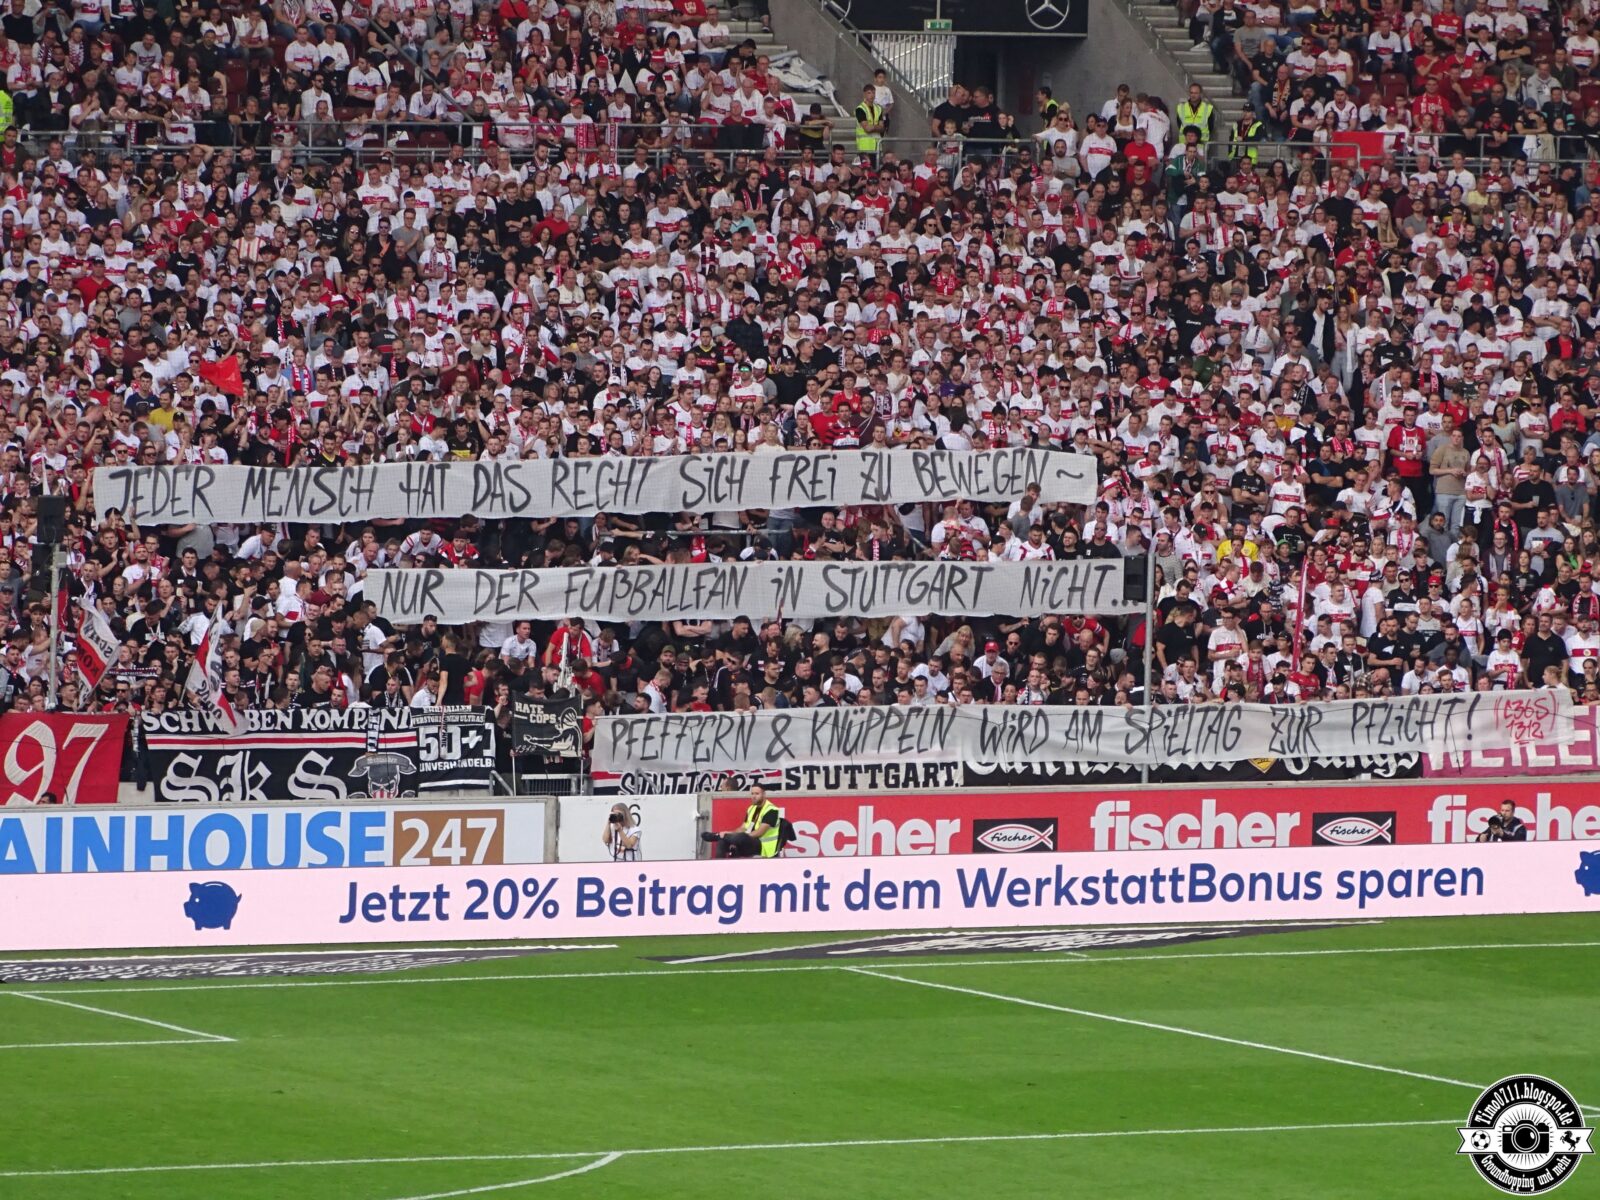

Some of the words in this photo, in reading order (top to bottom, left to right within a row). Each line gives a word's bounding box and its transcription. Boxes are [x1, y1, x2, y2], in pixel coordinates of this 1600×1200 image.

[108, 465, 215, 518] JEDER
[241, 463, 377, 518] MENSCH
[399, 461, 451, 515] HAT
[472, 462, 532, 513] DAS
[551, 457, 658, 512] RECHT
[861, 452, 892, 500] ZU
[914, 448, 1049, 497] BEWEGEN
[381, 569, 444, 616] NUR
[475, 570, 540, 614] DER
[822, 563, 996, 613] STUTTGART
[141, 708, 294, 733] SCHWBEN
[515, 702, 544, 713] HATE
[529, 713, 557, 723] COPS
[611, 713, 755, 762] PFEFFERN
[766, 713, 796, 762] &
[1064, 709, 1104, 755] AM
[1268, 705, 1323, 753] ZUR
[4, 720, 110, 806] 97
[401, 817, 498, 866] 247
[990, 831, 1036, 843] fischer
[1090, 799, 1300, 851] fischer
[1329, 825, 1374, 837] fischer
[339, 881, 450, 925] Jetzt
[464, 877, 560, 920] 20%
[576, 874, 745, 925] Beitrag
[759, 870, 829, 913] mit
[844, 868, 942, 911] dem
[956, 861, 1323, 909] WerkstattBonus
[1336, 862, 1486, 909] sparen
